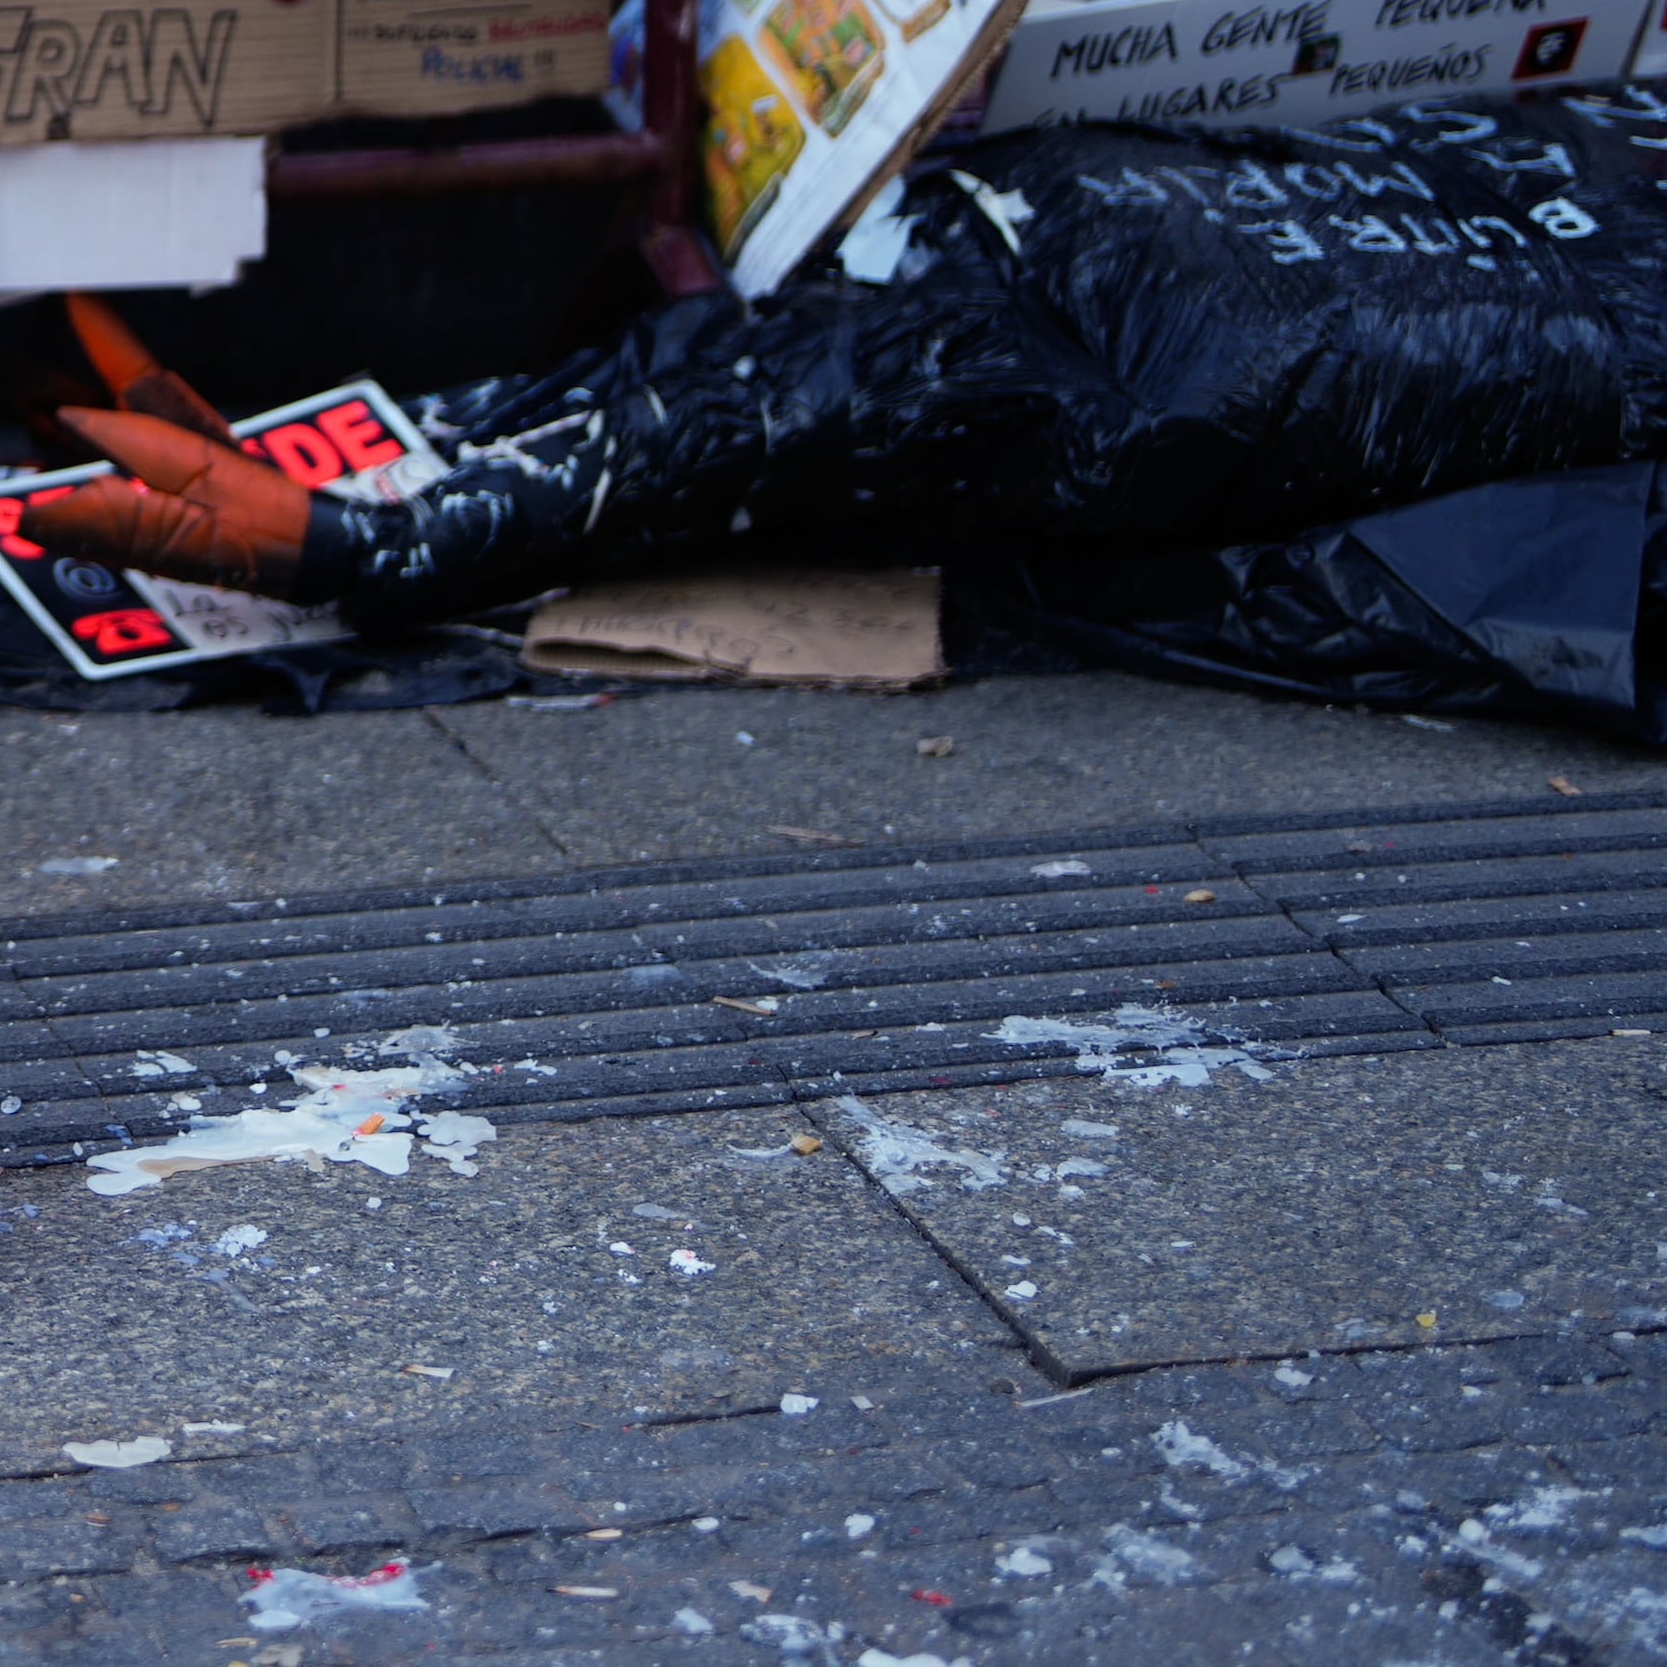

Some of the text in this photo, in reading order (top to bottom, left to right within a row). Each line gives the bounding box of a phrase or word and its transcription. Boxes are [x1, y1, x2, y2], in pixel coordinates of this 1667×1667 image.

[1051, 22, 1177, 82] MUCHA
[1201, 0, 1334, 58] GENTE
[1115, 44, 1494, 125] LUGARES PEQUEÑOS
